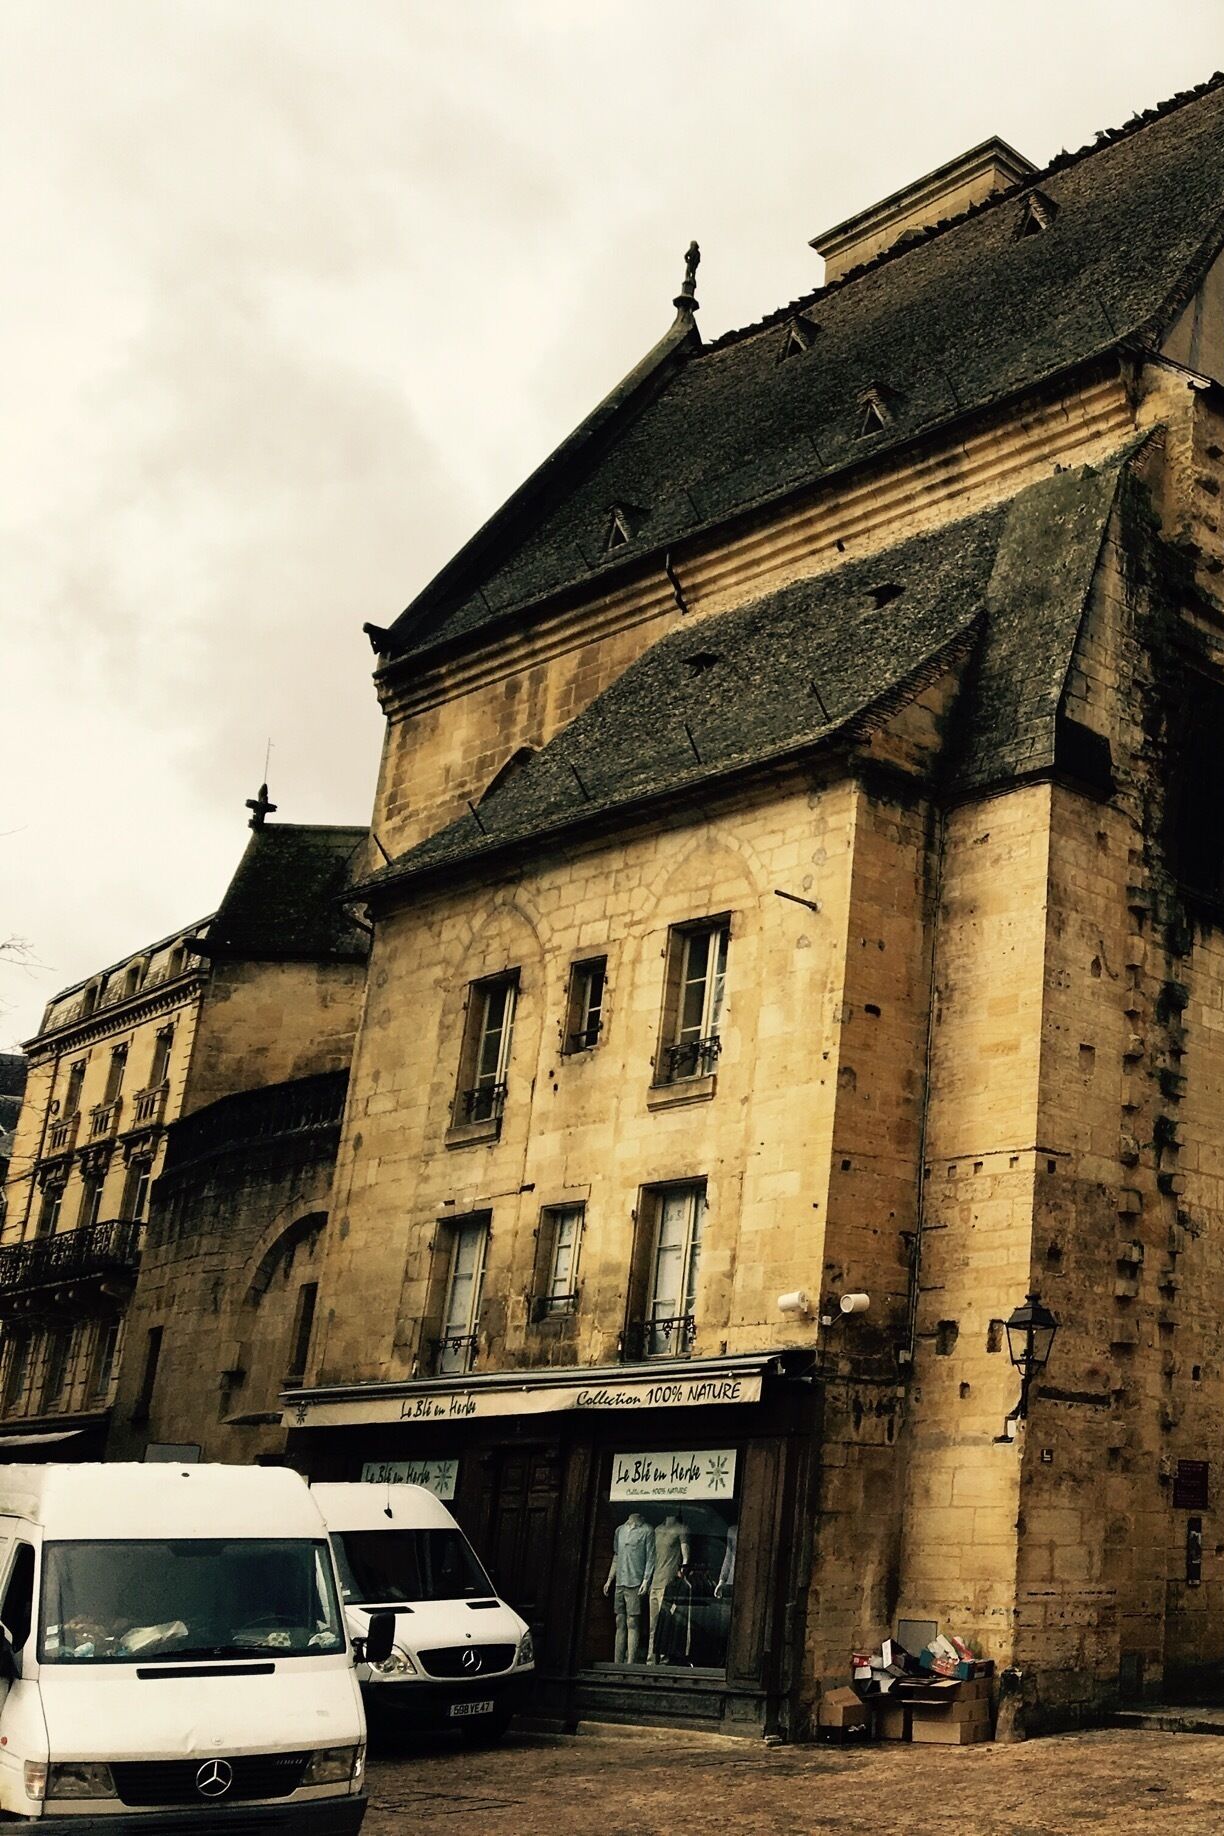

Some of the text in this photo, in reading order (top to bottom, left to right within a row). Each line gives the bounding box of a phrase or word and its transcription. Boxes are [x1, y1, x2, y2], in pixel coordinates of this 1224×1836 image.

[400, 1393, 476, 1420] Le Blé en Herbe
[576, 1382, 742, 1406] Collection 100% NATURE
[406, 1461, 431, 1484] Herbe
[616, 1454, 701, 1484] Le Blé en Herbe
